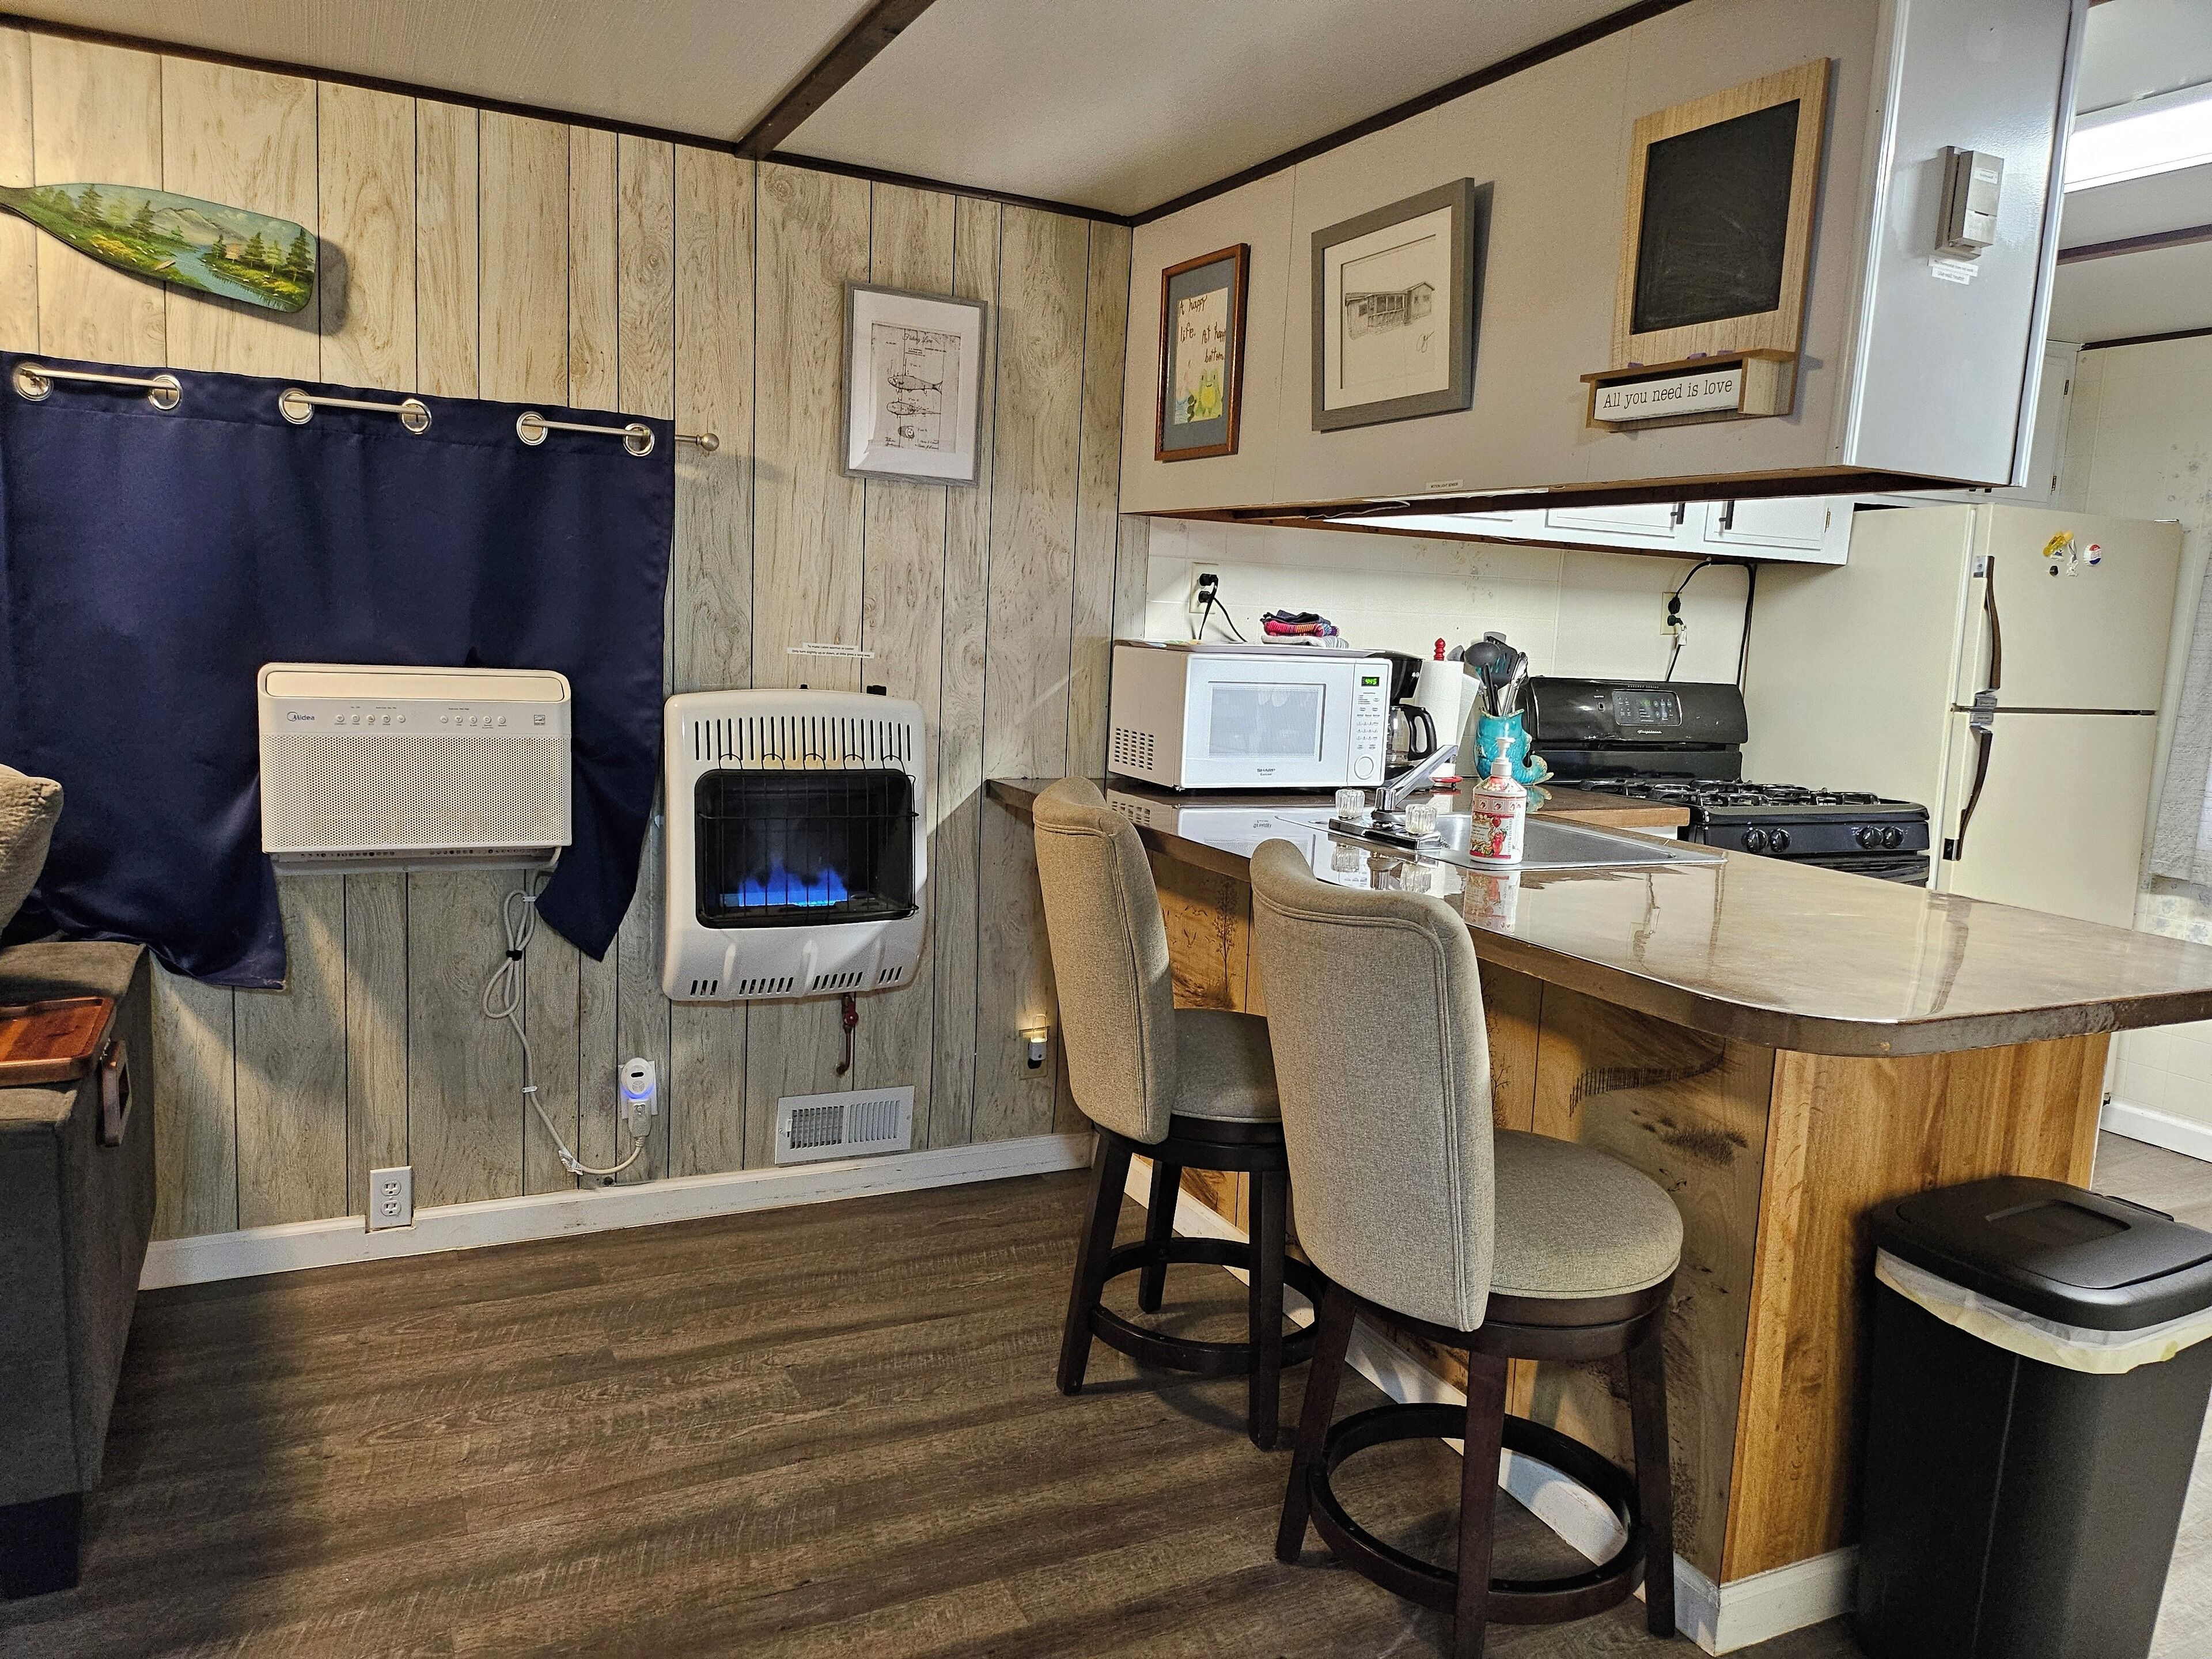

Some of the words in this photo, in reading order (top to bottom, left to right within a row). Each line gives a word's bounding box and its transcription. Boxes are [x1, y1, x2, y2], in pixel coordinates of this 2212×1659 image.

[1188, 294, 1207, 312] happy
[1603, 392, 1620, 408] All
[1624, 392, 1647, 409] you
[1652, 384, 1683, 402] need
[1687, 382, 1698, 397] is
[1703, 380, 1733, 395] love
[287, 711, 315, 722] Midea
